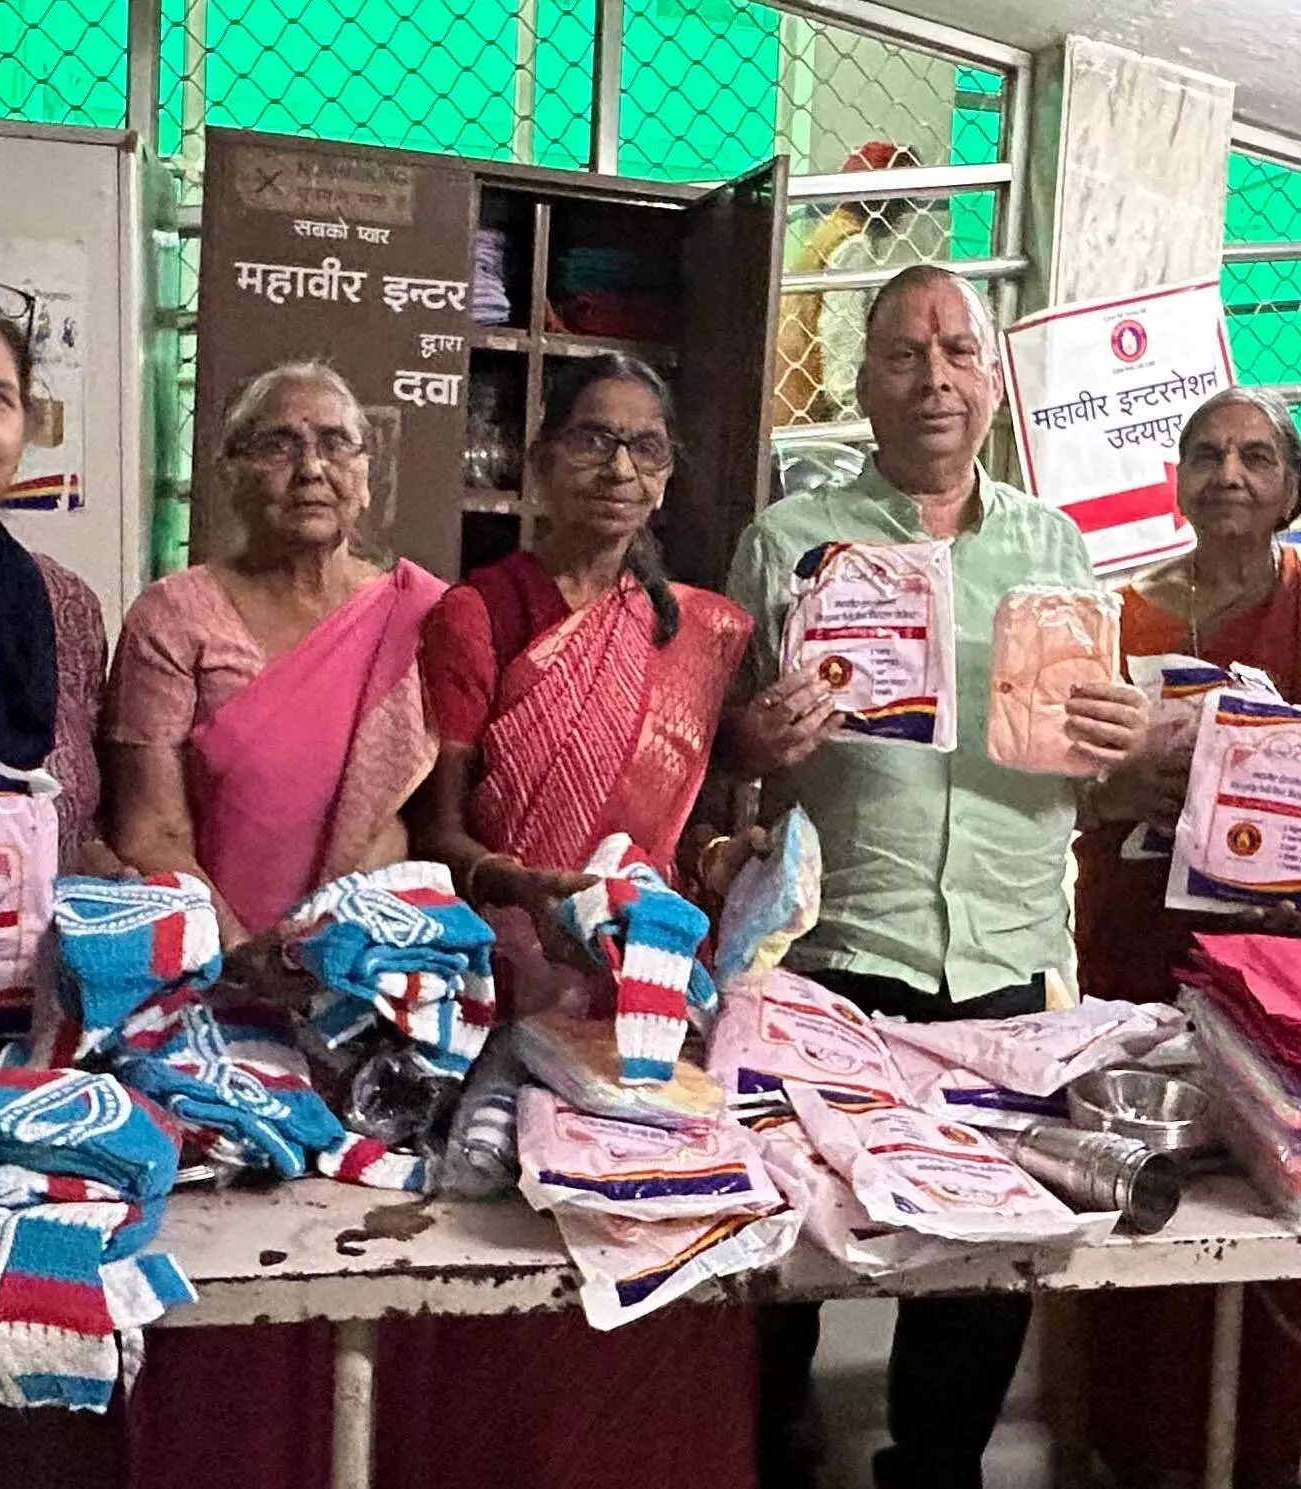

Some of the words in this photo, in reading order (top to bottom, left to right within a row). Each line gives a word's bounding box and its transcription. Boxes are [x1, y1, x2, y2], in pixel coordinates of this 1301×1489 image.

[294, 216, 349, 240] सबको
[357, 226, 391, 245] प्यार
[235, 257, 368, 303] महावीर
[383, 275, 468, 312] इन्टर
[420, 333, 463, 358] द्वारा
[393, 369, 462, 406] दवा
[1032, 392, 1109, 430] महावीर
[1116, 368, 1218, 416] इन्टरनेशन
[1104, 414, 1183, 449] उदयपुर
